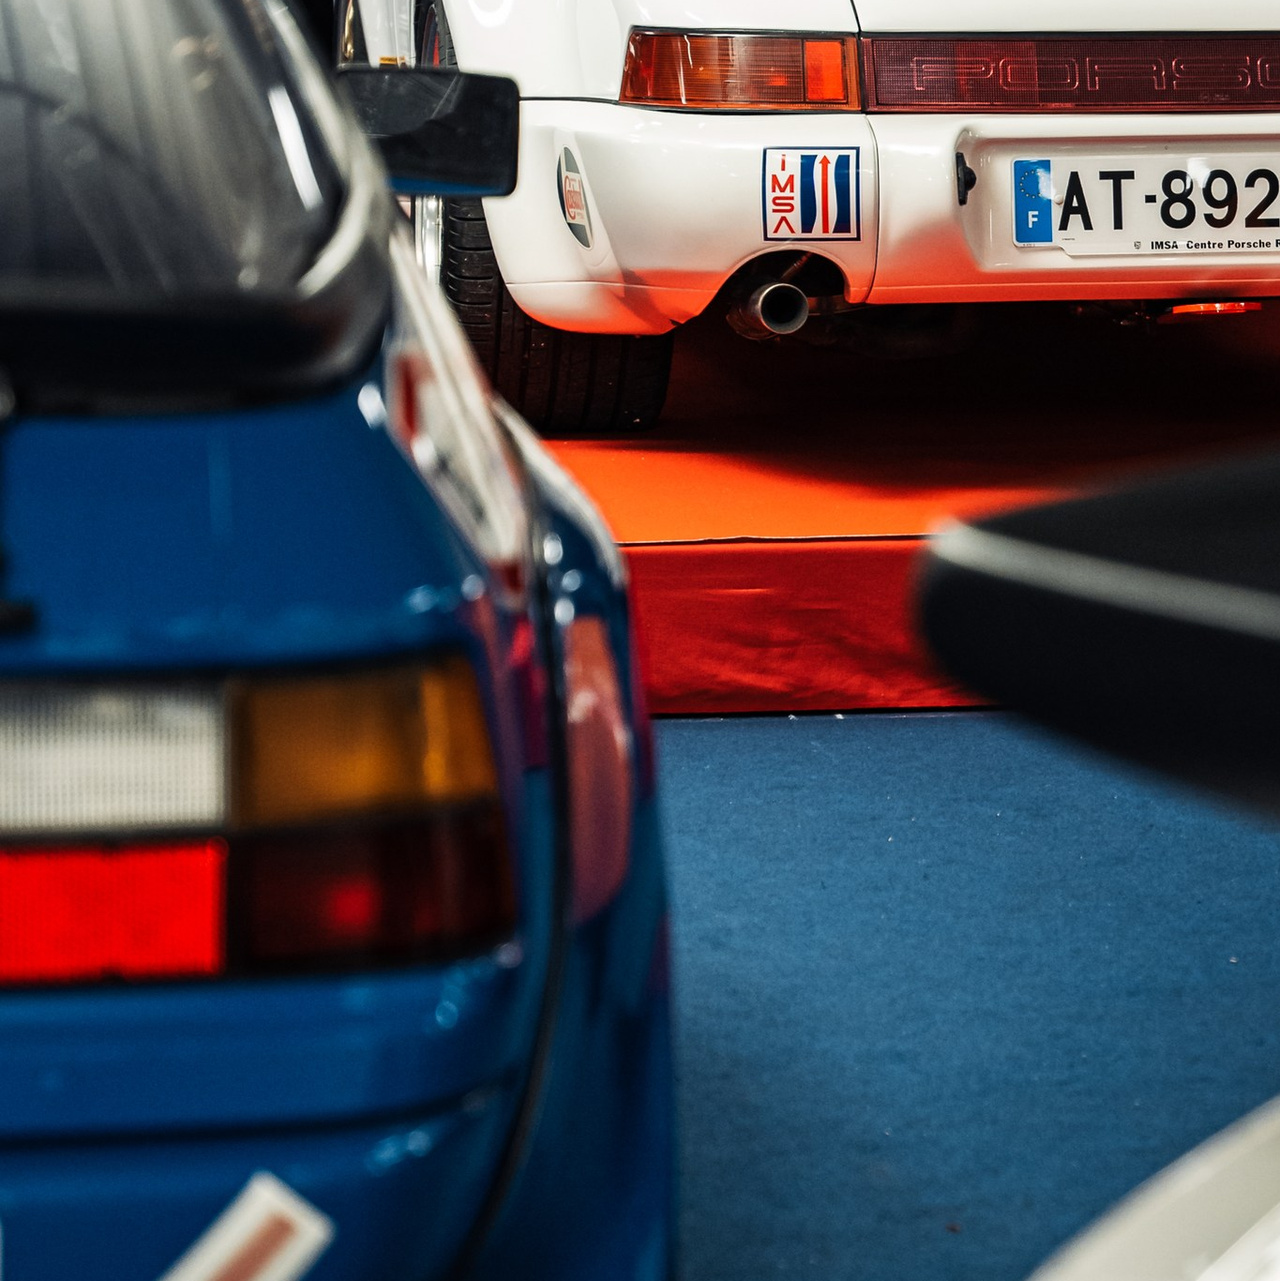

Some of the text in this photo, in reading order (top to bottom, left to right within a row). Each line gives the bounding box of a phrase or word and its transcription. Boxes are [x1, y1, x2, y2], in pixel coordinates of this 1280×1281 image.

[771, 153, 796, 234] IMSA
[1027, 211, 1039, 228] F
[1150, 240, 1179, 250] IMSA
[1186, 240, 1223, 249] Centre
[1227, 240, 1271, 249] Porsche
